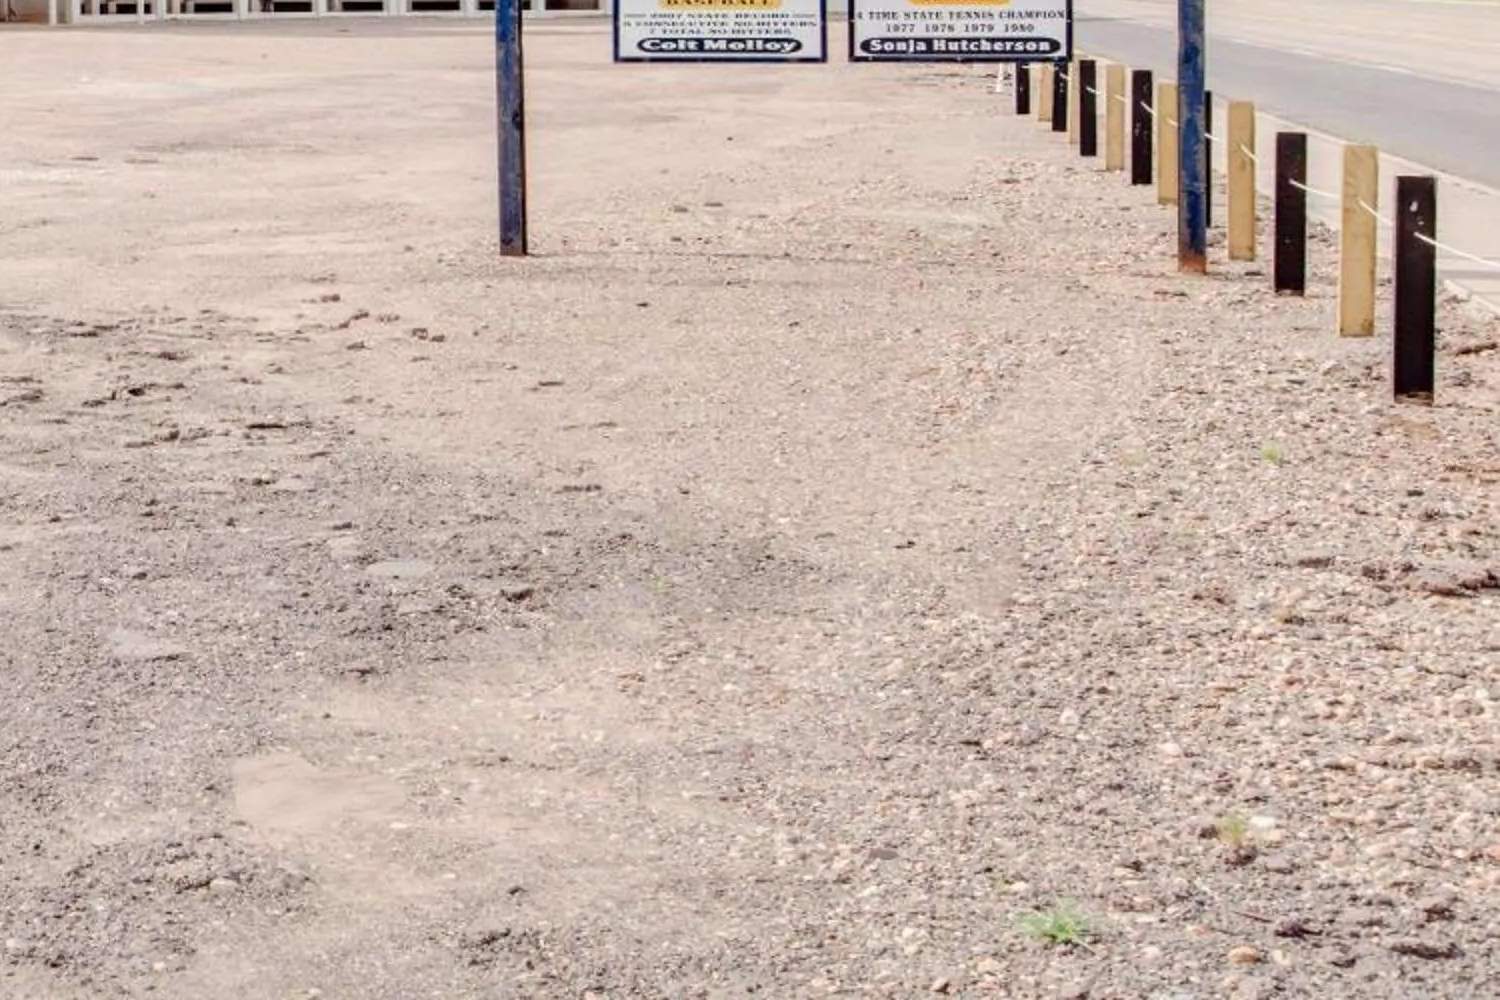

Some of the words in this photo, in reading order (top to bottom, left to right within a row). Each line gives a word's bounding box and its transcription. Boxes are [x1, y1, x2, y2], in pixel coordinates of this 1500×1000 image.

[868, 11, 898, 20] TIME
[904, 11, 943, 20] STATE
[949, 11, 994, 20] TENNIS
[999, 11, 1065, 20] CHAMPION
[964, 23, 994, 33] 1979
[641, 38, 699, 51] Colt
[703, 39, 797, 53] Molloy
[870, 39, 927, 53] Sonja
[933, 39, 1051, 52] Hutcherson
